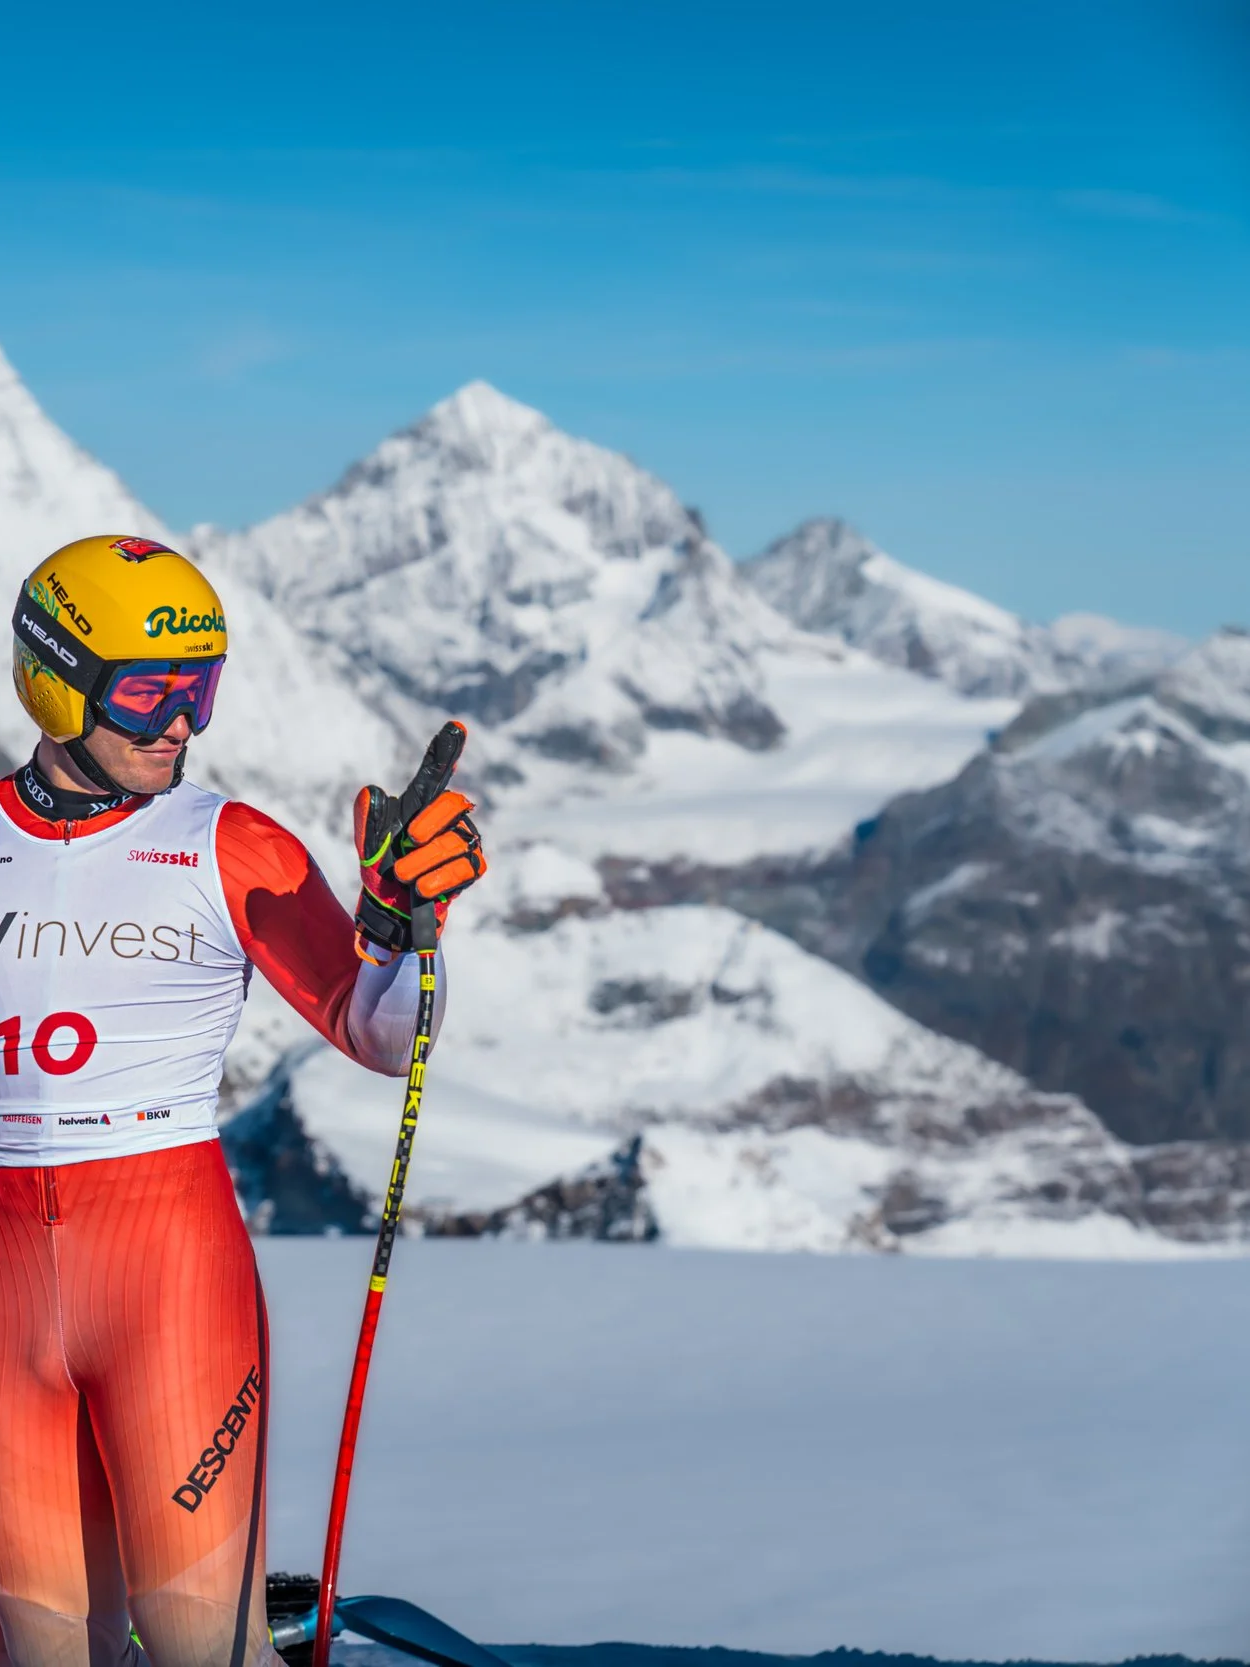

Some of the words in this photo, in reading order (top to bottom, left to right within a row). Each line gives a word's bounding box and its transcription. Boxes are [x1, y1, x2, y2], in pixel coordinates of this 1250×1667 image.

[47, 572, 93, 636] HEAD
[21, 613, 78, 668] HEAD
[127, 848, 199, 868] swissski
[403, 1035, 430, 1127] LEKI
[2, 1114, 42, 1125] RAIFFEISEN
[58, 1116, 99, 1126] helvetia
[146, 1110, 171, 1121] BKW
[171, 1364, 263, 1514] DESCENTE
